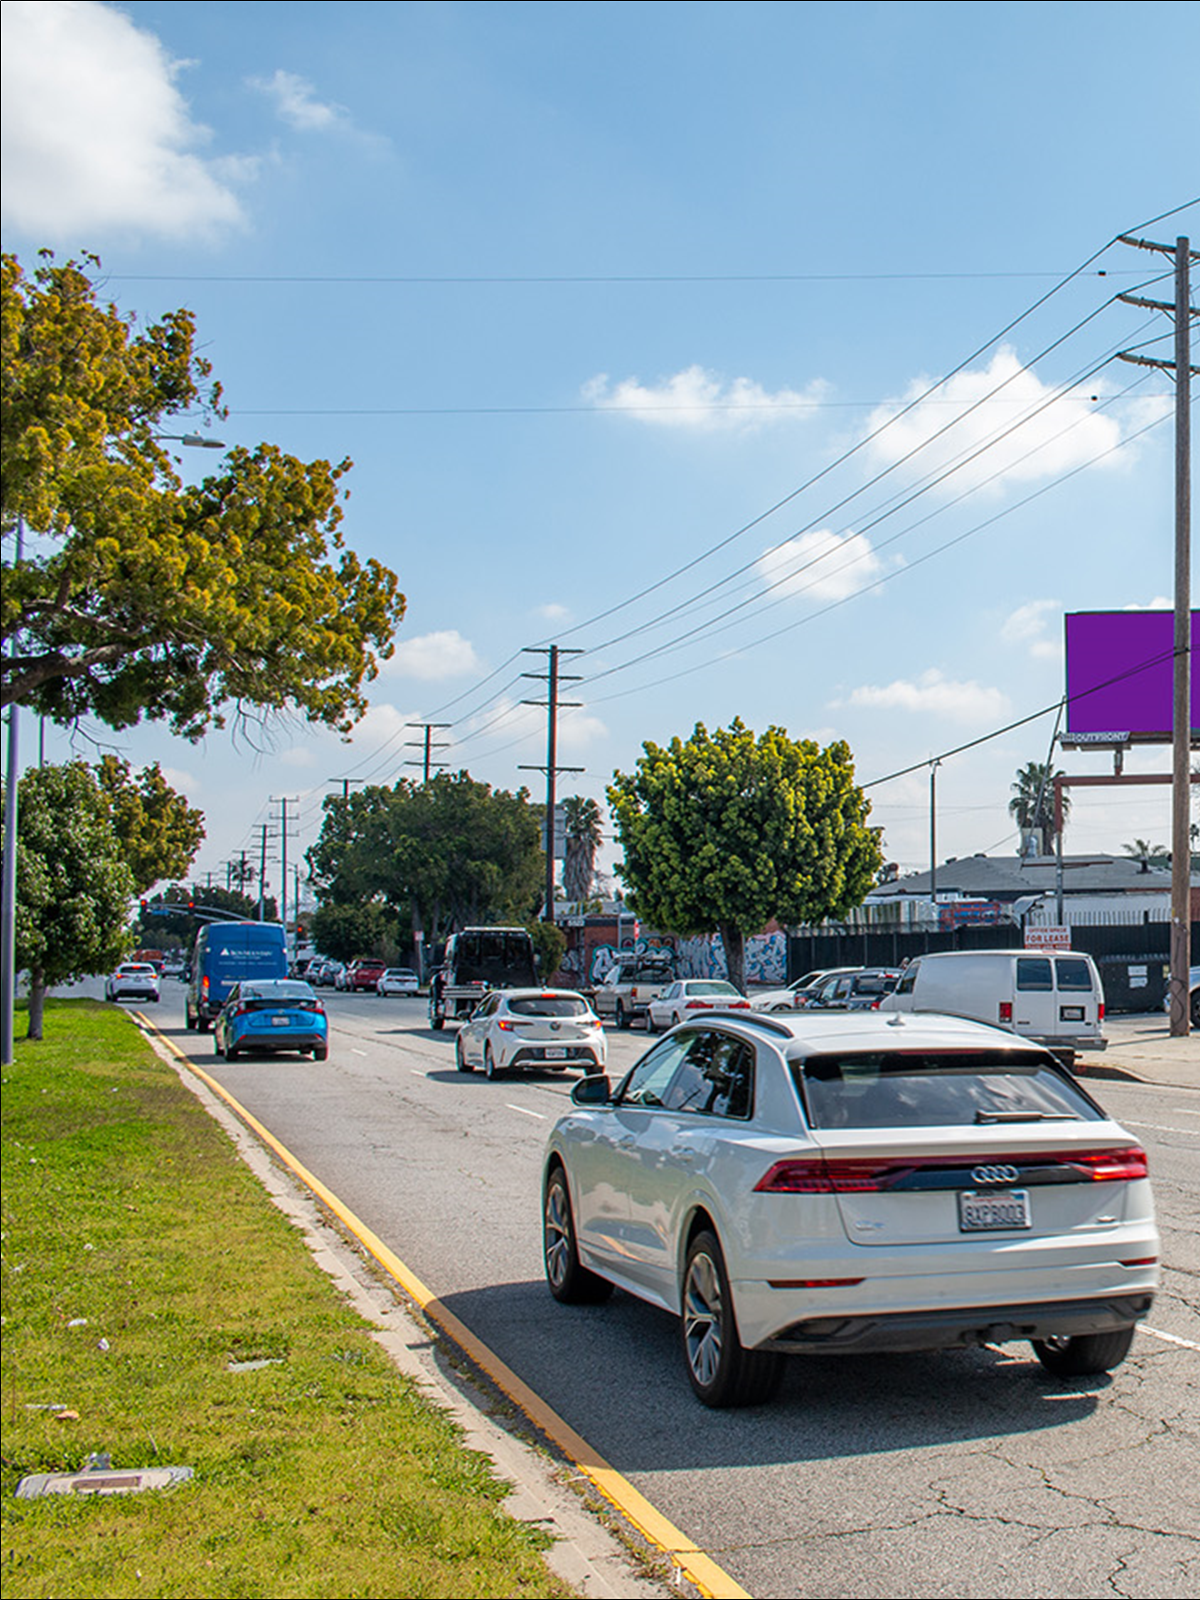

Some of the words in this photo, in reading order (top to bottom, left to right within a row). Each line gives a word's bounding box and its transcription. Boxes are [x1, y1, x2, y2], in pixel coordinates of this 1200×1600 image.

[1074, 733, 1129, 742] OUTFRONT
[1026, 934, 1042, 942] FOR
[1043, 934, 1069, 942] LEASE
